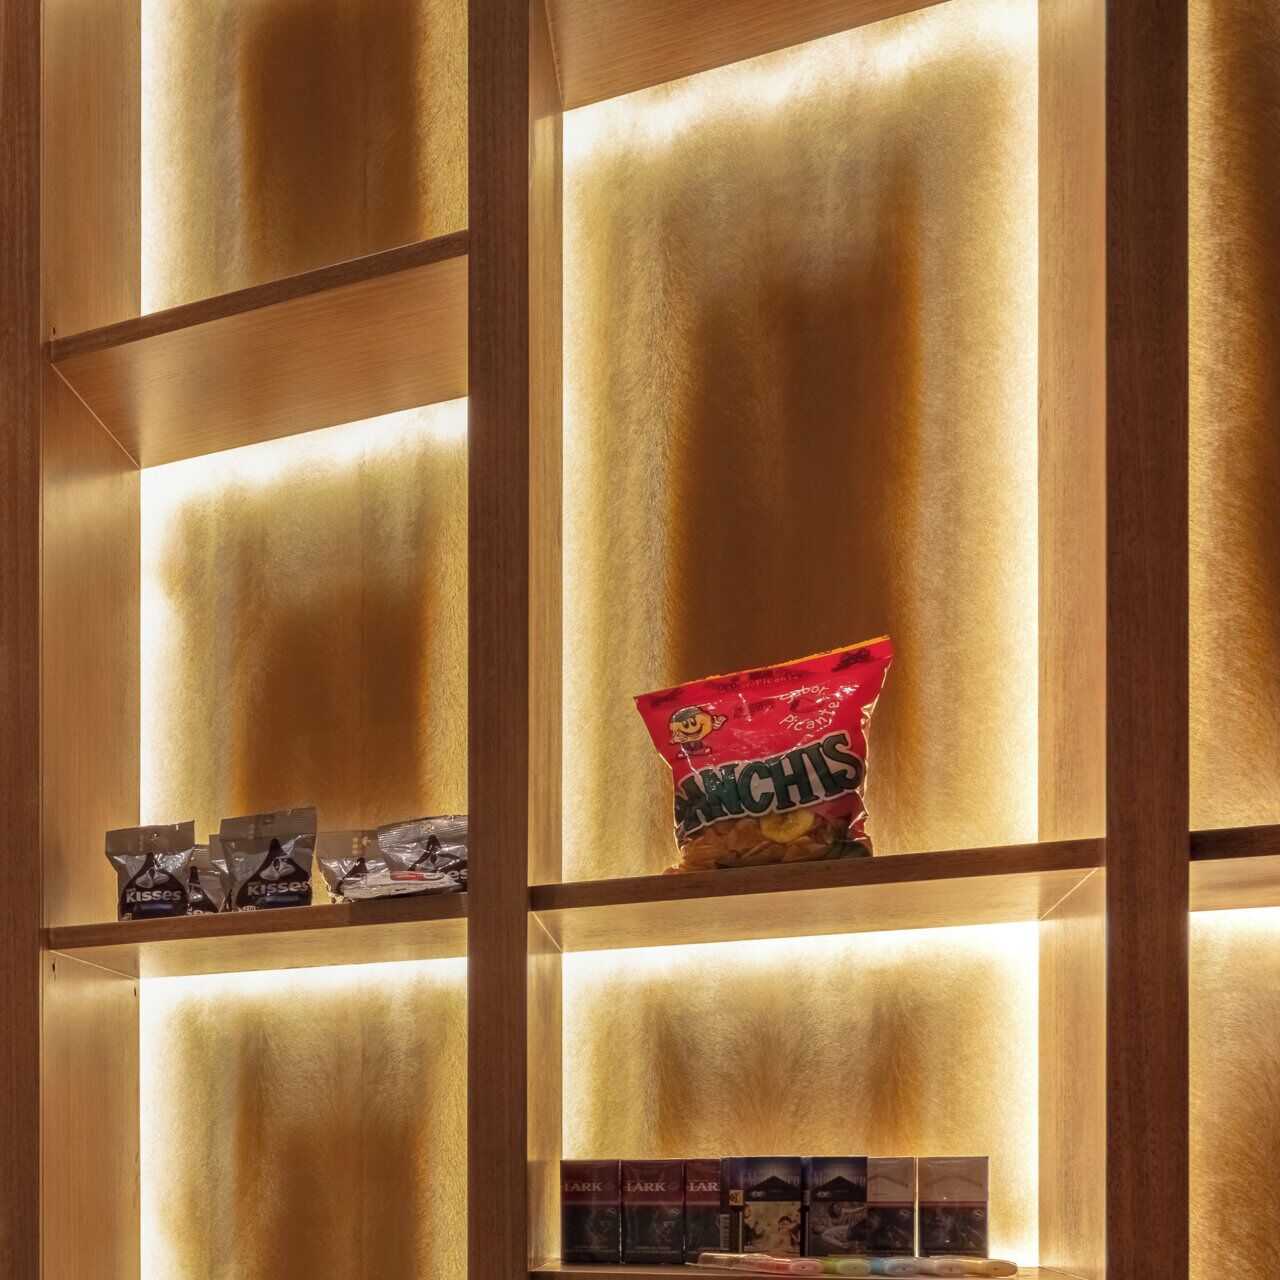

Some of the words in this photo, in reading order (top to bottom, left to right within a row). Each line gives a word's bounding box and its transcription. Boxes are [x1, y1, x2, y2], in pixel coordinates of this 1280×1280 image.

[778, 700, 840, 732] Picante
[565, 1182, 603, 1192] LARK
[627, 1182, 666, 1192] LARK
[690, 1182, 721, 1192] LAR
